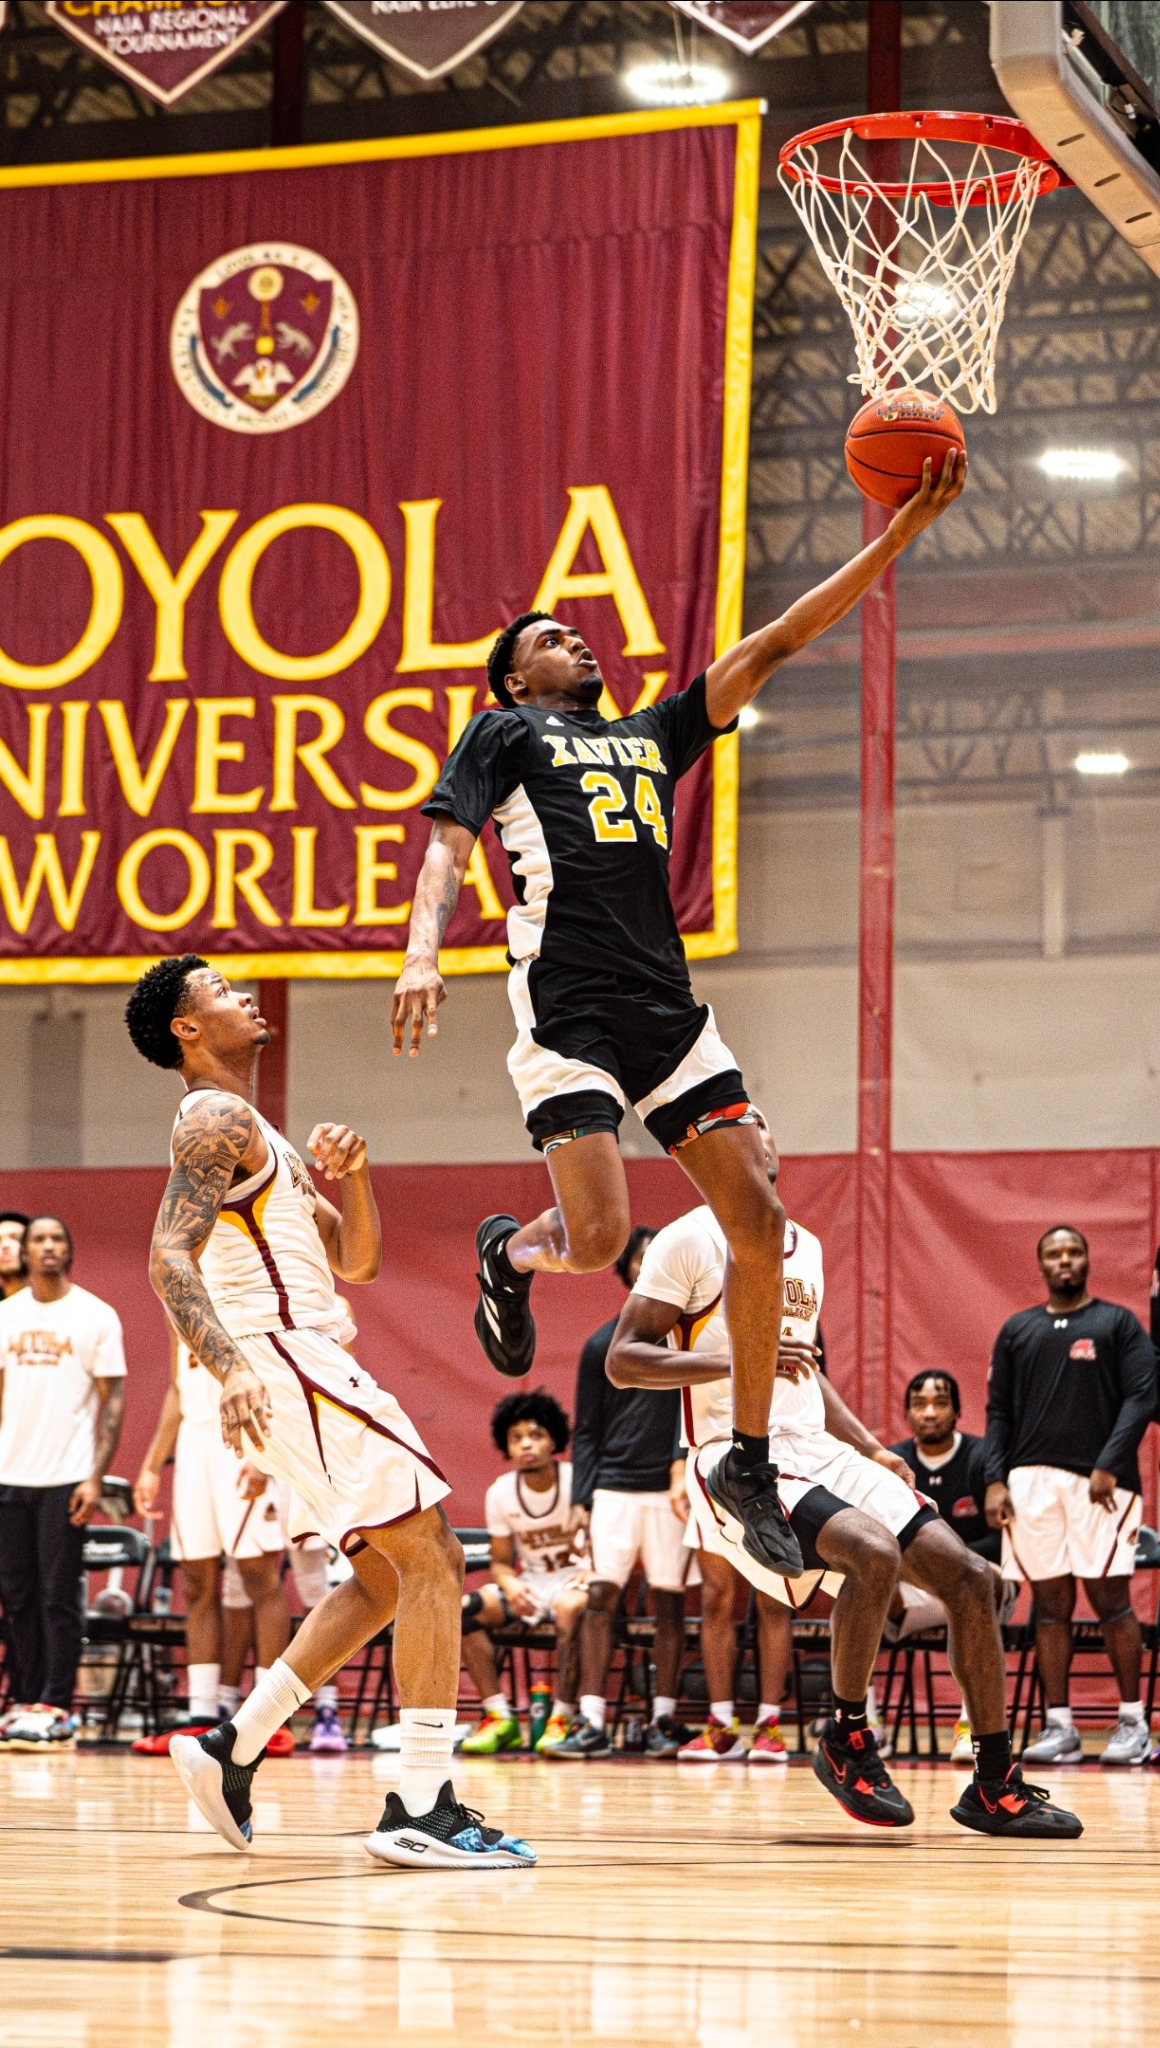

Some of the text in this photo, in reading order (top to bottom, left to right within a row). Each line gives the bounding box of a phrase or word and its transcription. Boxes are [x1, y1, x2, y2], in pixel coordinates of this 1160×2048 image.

[95, 15, 144, 35] NAIA
[149, 6, 249, 32] REGIONAL
[106, 27, 239, 55] TOURNAMENT
[0, 672, 667, 819] NIVERSI
[541, 734, 668, 775] XAVIER
[579, 771, 668, 850] 24
